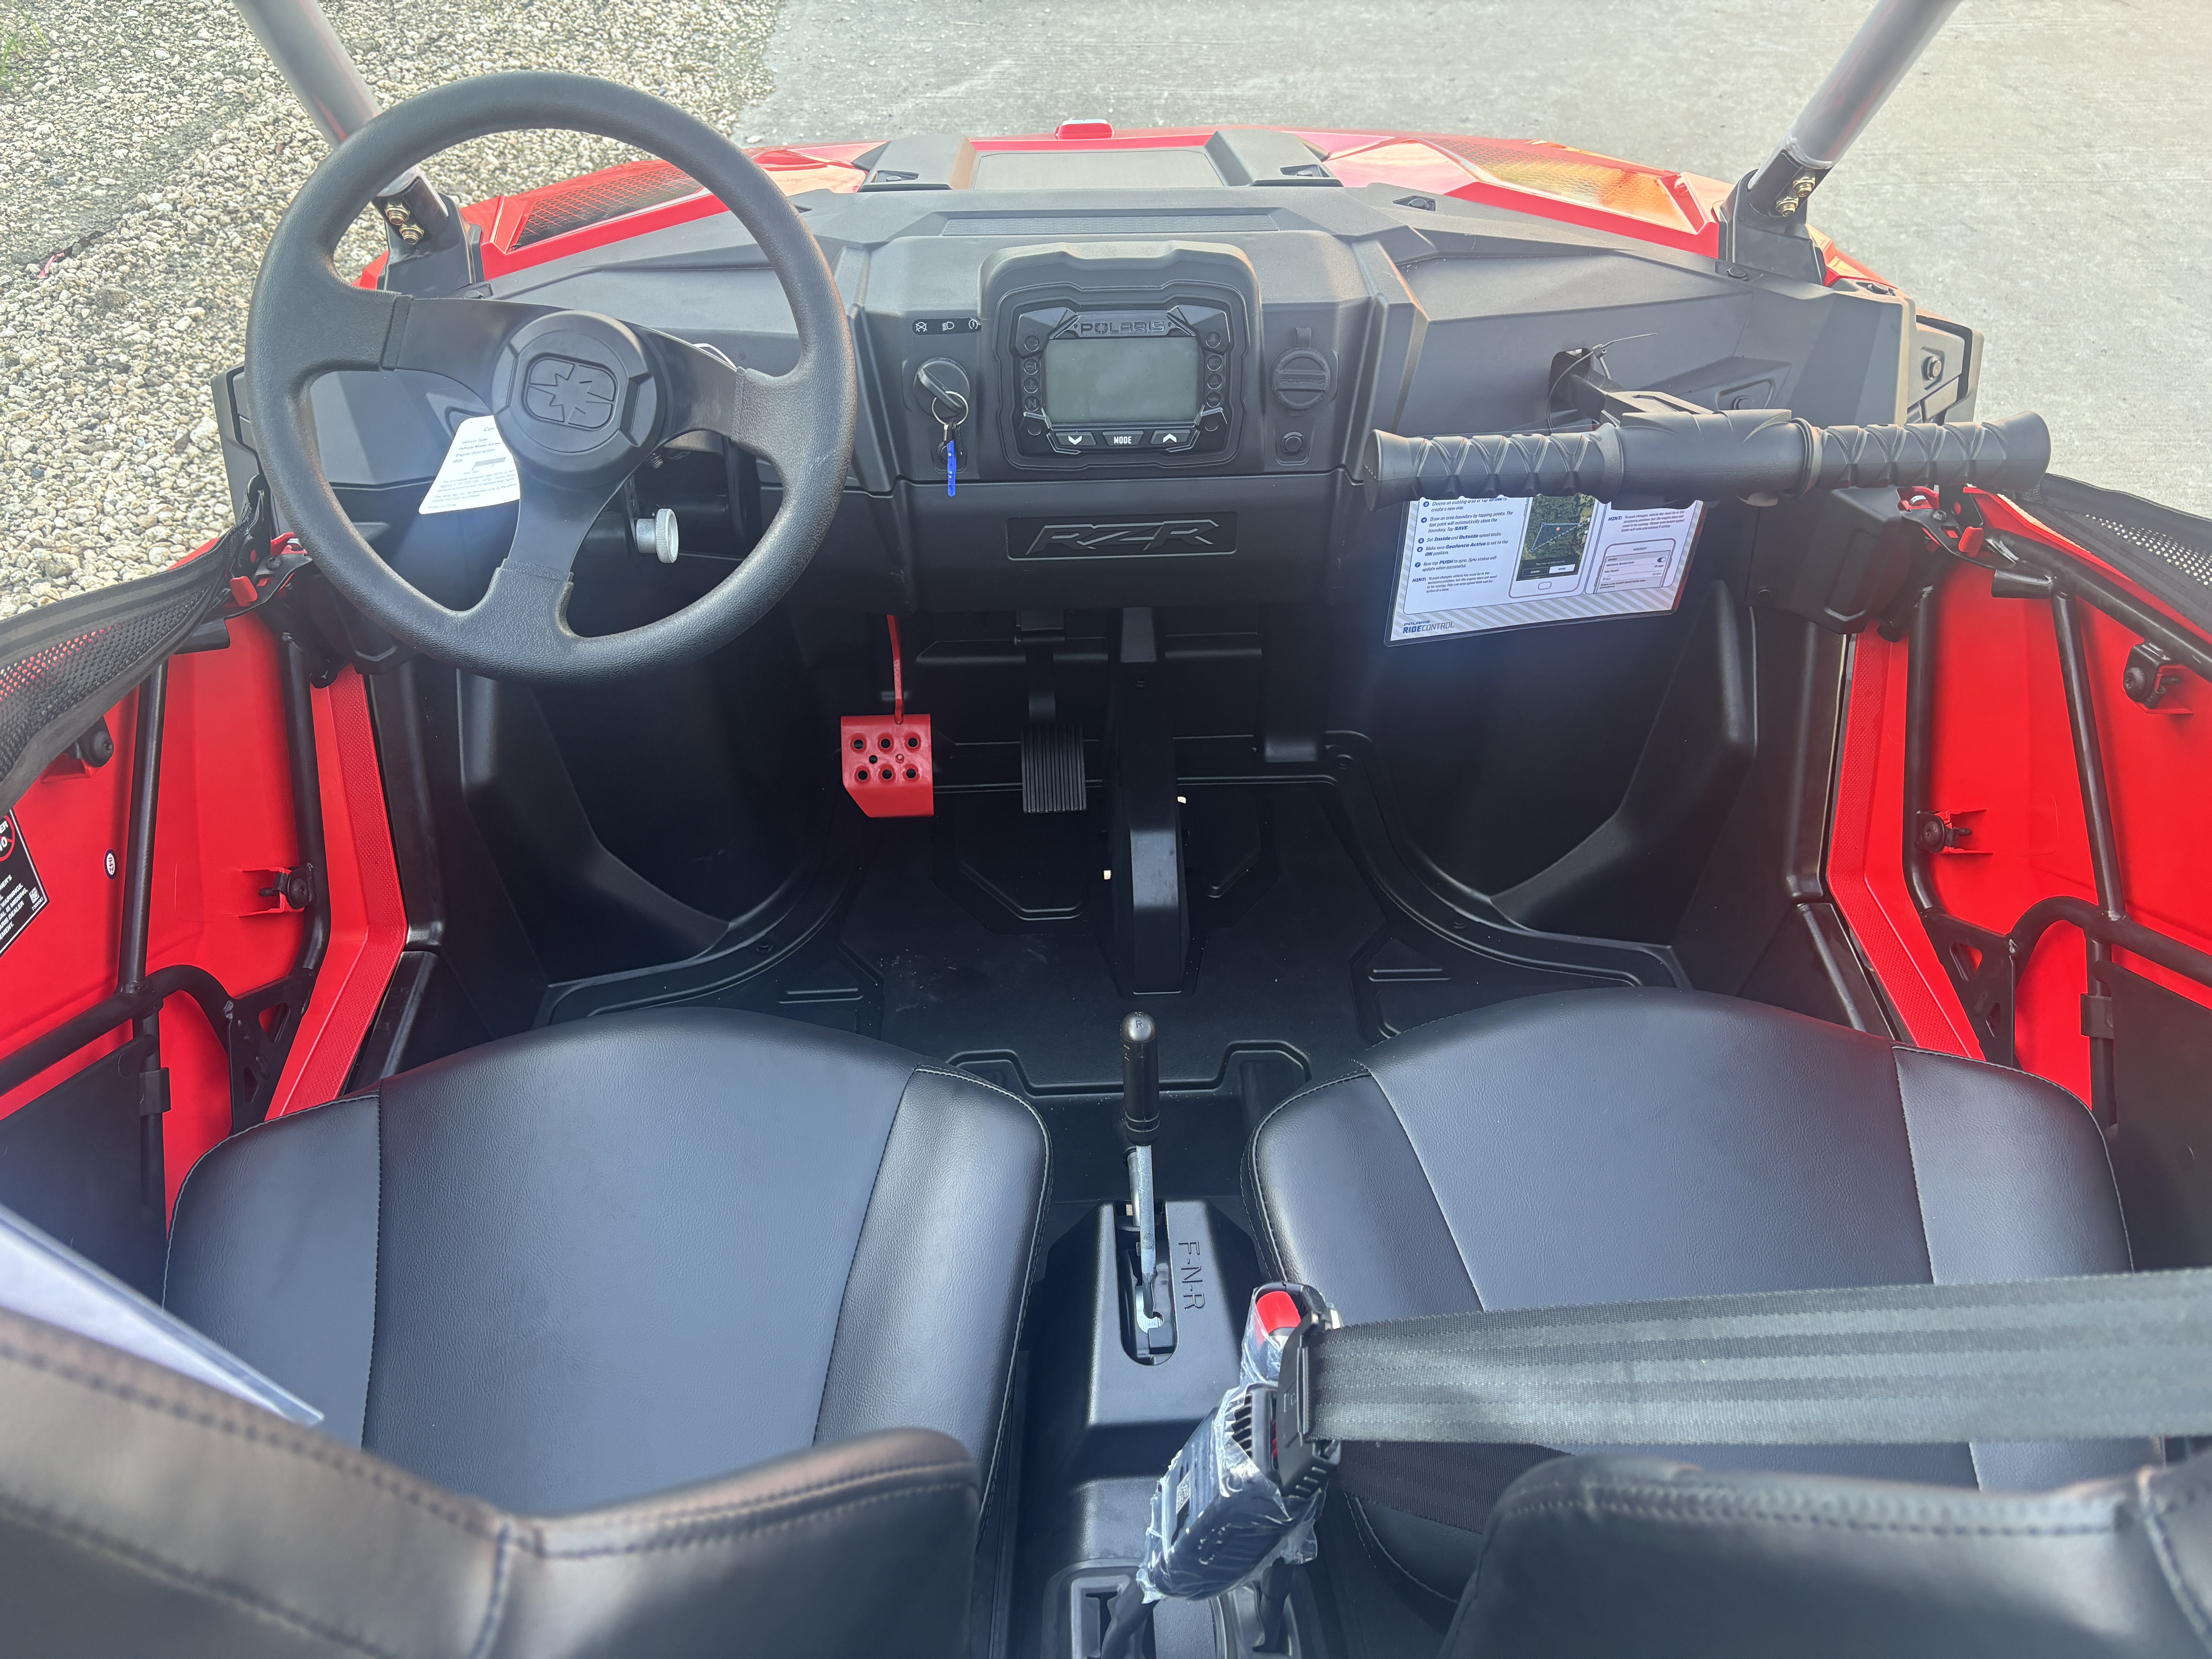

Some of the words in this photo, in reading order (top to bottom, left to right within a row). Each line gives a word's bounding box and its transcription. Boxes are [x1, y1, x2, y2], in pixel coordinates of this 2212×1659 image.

[1080, 321, 1165, 334] POLARIS
[1114, 436, 1132, 444] MODE
[1025, 519, 1219, 555] RZR
[1403, 621, 1455, 633] RIDECONTROL
[1, 883, 23, 908] WARNINGS.
[8, 900, 24, 920] DEALER
